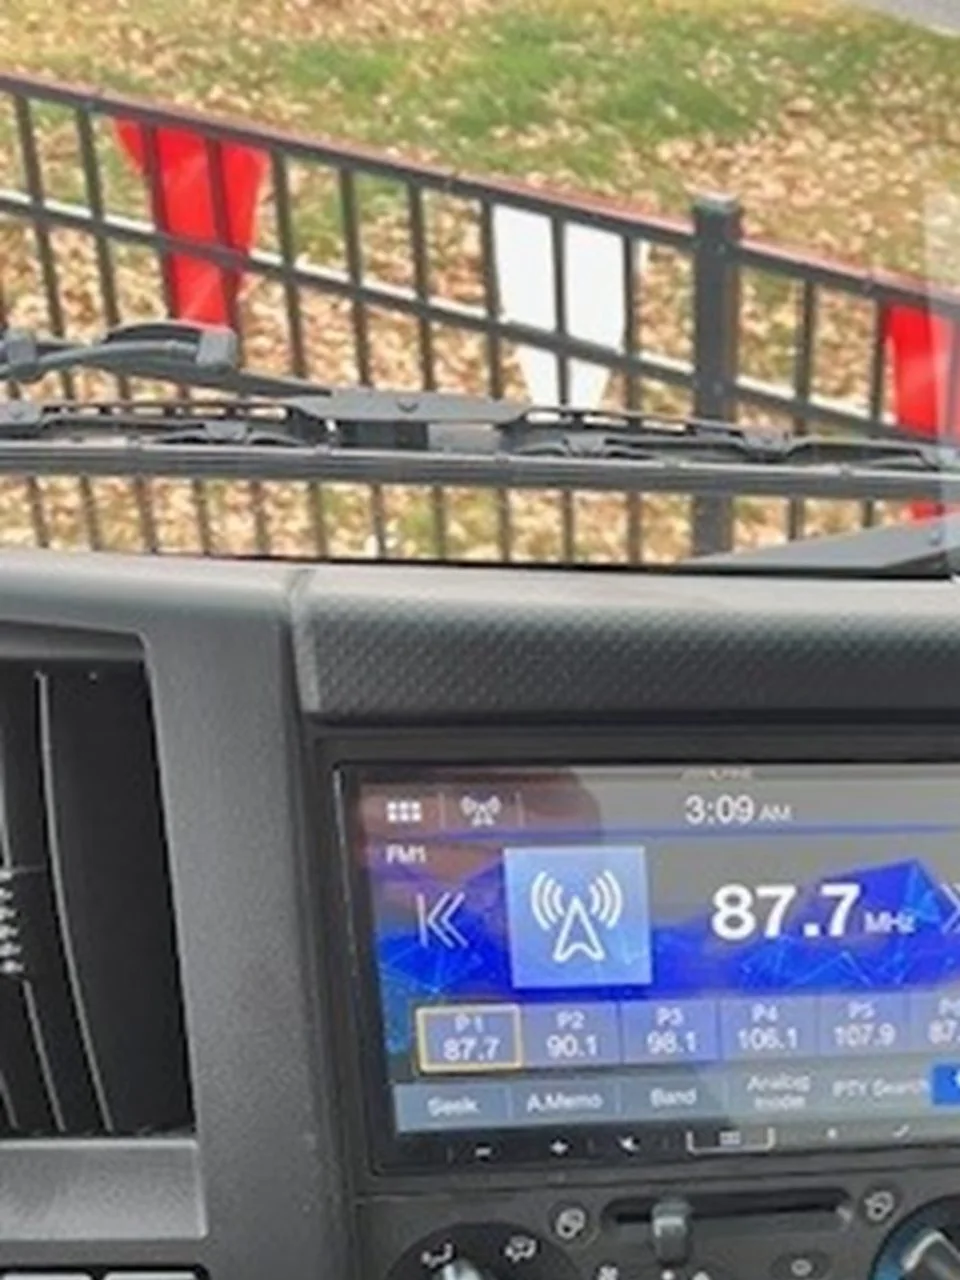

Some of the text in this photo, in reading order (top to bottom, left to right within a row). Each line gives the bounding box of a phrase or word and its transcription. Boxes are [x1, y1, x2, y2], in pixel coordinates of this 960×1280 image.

[685, 795, 792, 825] 3:09 AM
[711, 884, 917, 941] 87.7 MHz
[556, 1011, 586, 1031] P2
[546, 1033, 598, 1059] 90.1
[834, 1022, 896, 1047] 107.9
[443, 1036, 500, 1062] 87.7
